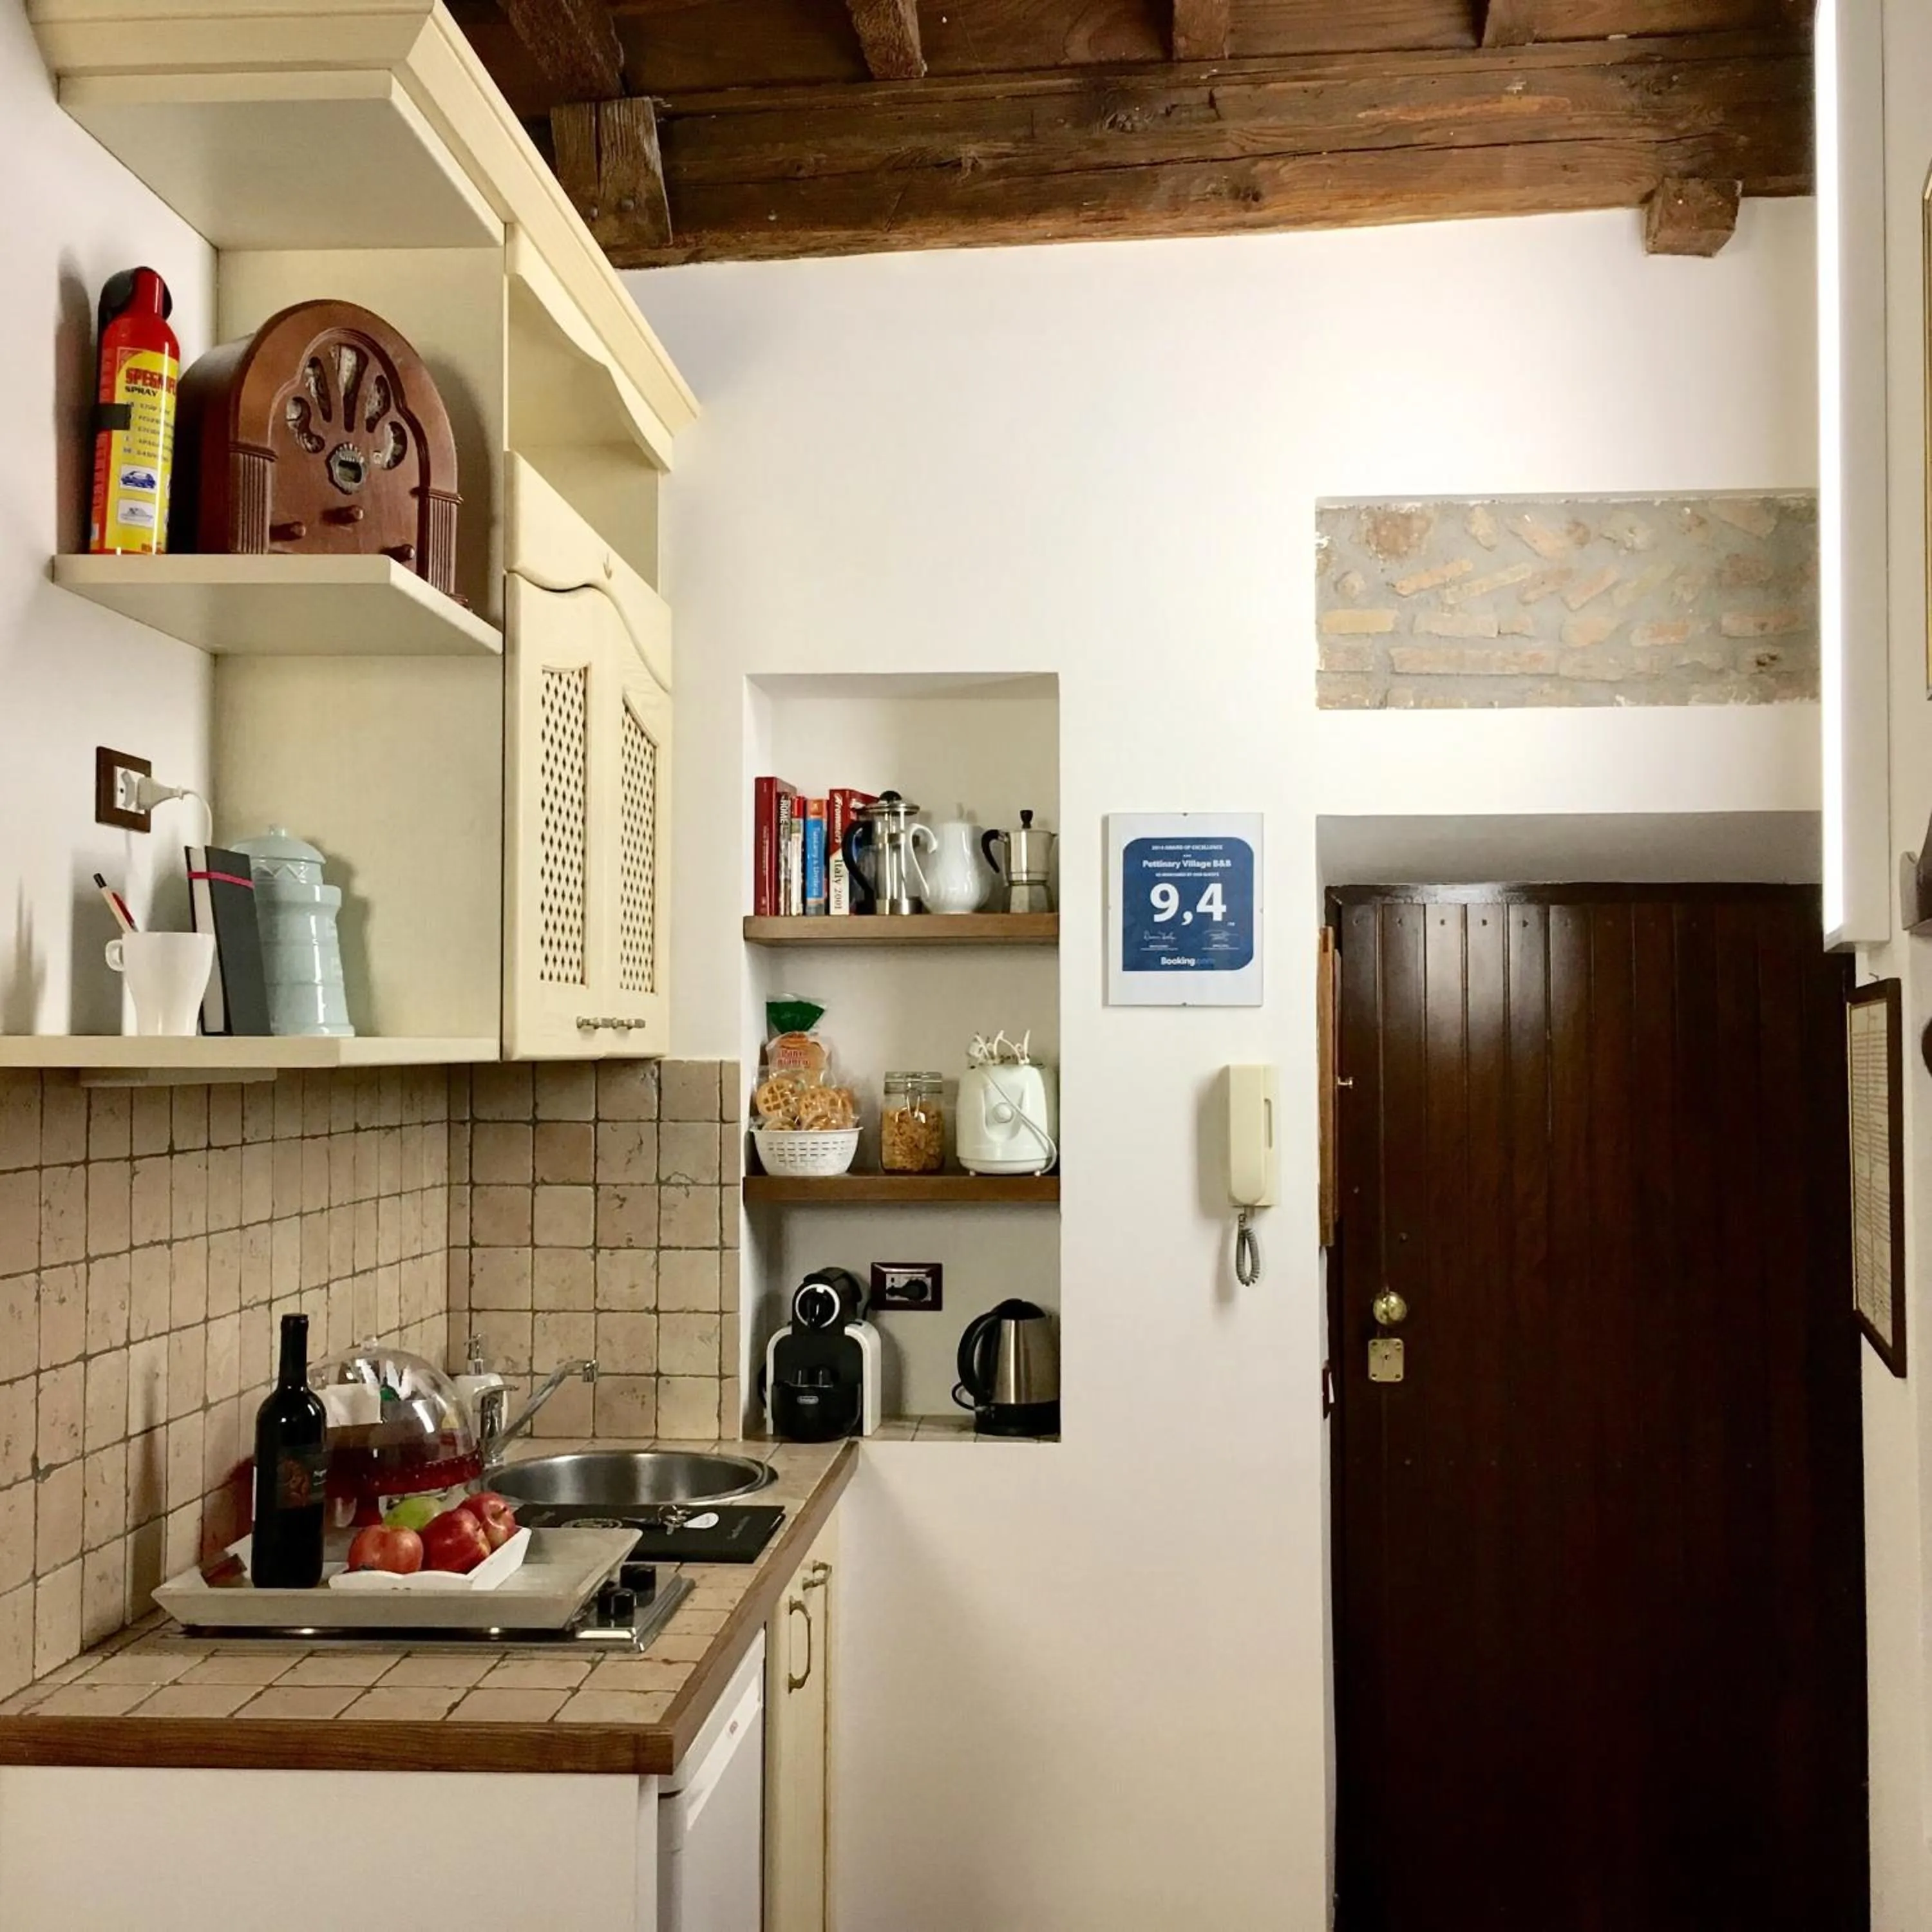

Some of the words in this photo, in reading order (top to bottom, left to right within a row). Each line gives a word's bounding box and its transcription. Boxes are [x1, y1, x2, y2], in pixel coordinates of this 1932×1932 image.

[126, 386, 158, 396] SPRAY
[780, 799, 790, 824] ROME
[832, 860, 843, 884] Italy
[1142, 860, 1180, 869] Pettinary
[1182, 860, 1211, 869] Village
[834, 888, 842, 909] 2001
[1150, 882, 1227, 925] 9,4
